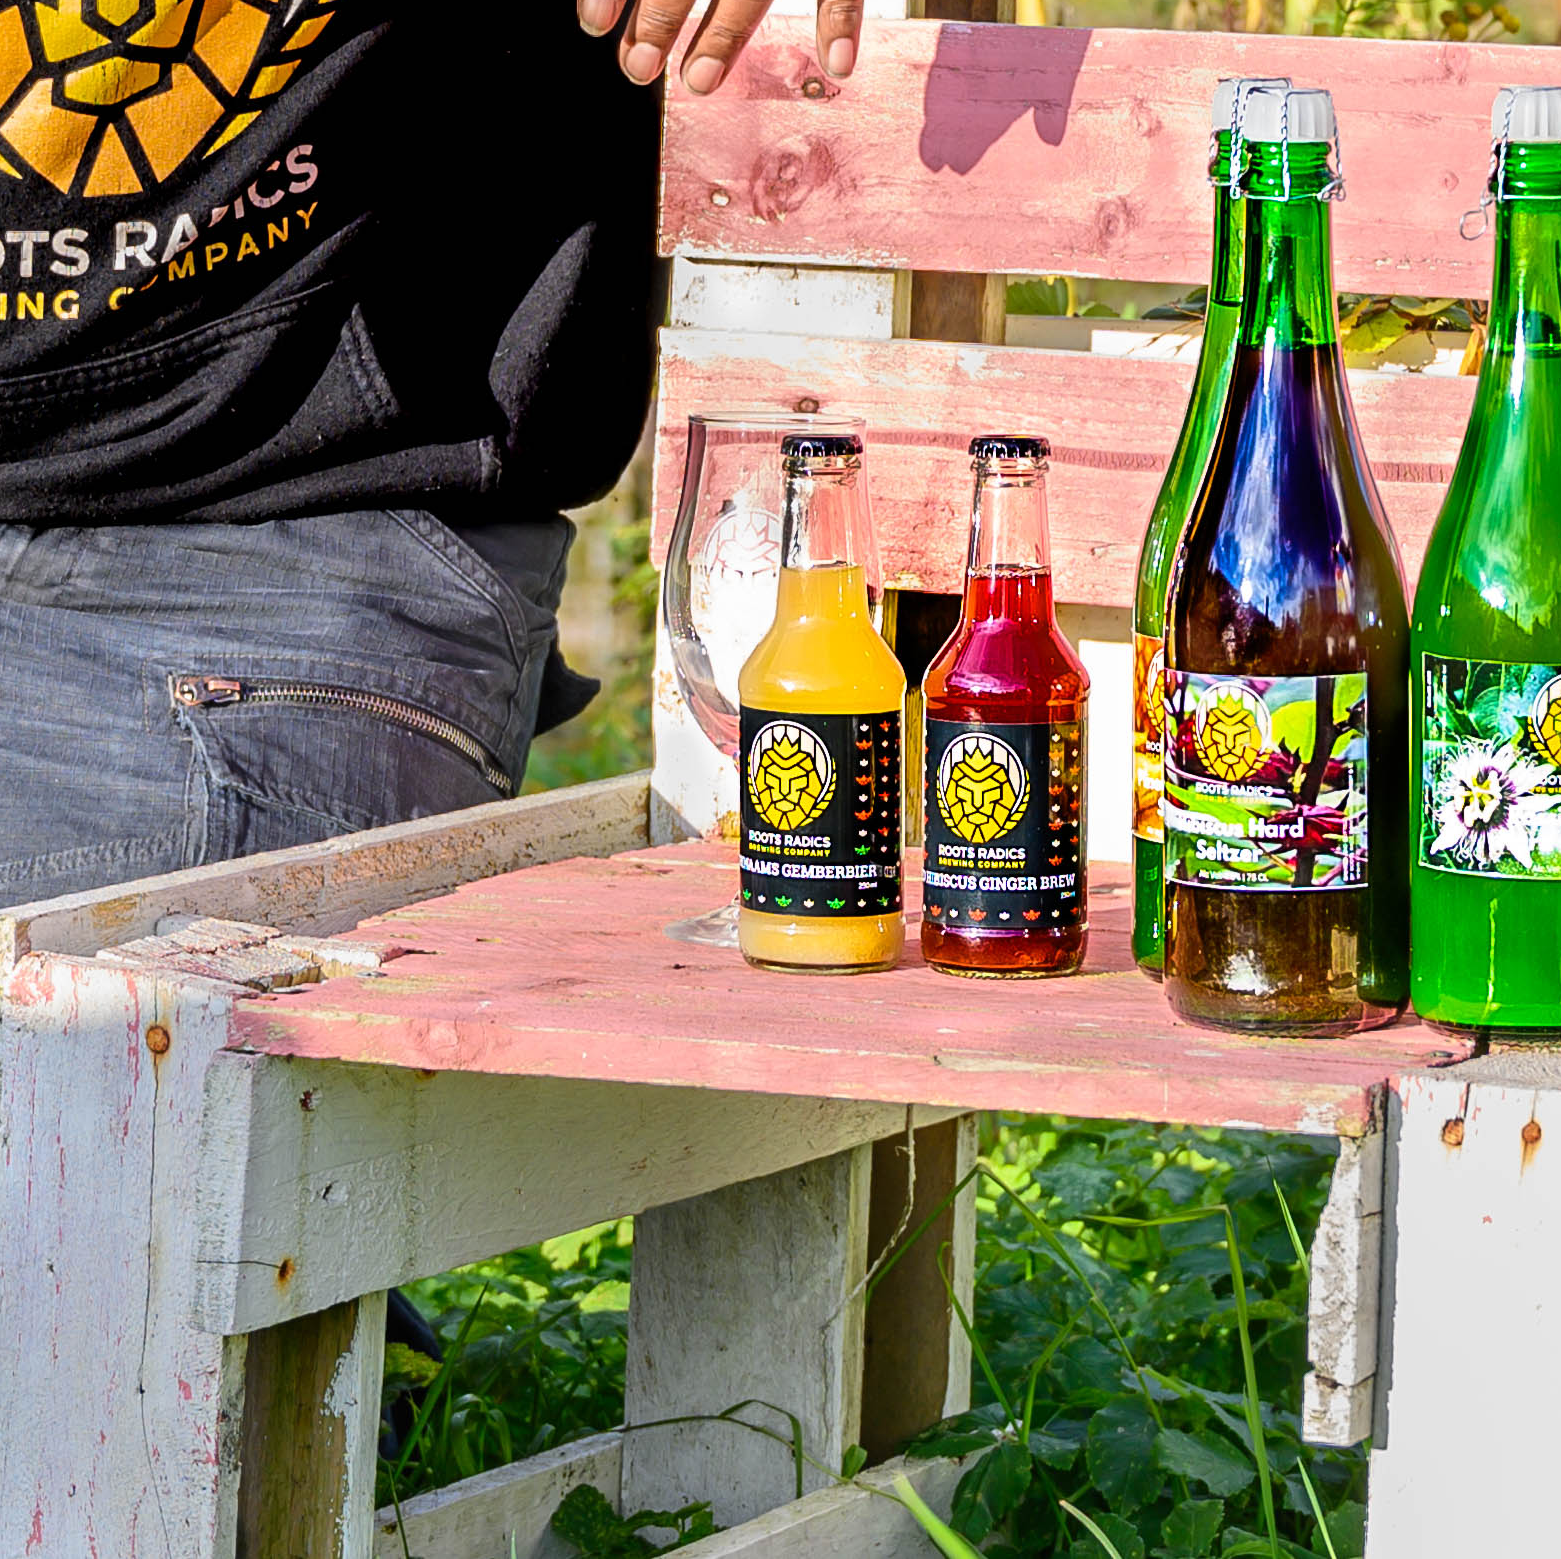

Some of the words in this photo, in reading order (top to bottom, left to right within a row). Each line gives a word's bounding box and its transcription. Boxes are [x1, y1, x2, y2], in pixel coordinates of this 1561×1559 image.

[113, 143, 319, 271] RAICS
[108, 201, 319, 311] CMPANY
[1248, 817, 1304, 839] Hard
[748, 829, 781, 845] ROOTS
[784, 834, 831, 848] RADICS
[938, 843, 975, 858] ROOTS
[977, 847, 1026, 860] RADICS
[1196, 839, 1263, 862] Seltzer
[781, 863, 878, 879] GEMBERBIER
[979, 876, 1038, 891] GINGER
[1040, 873, 1076, 890] BREW
